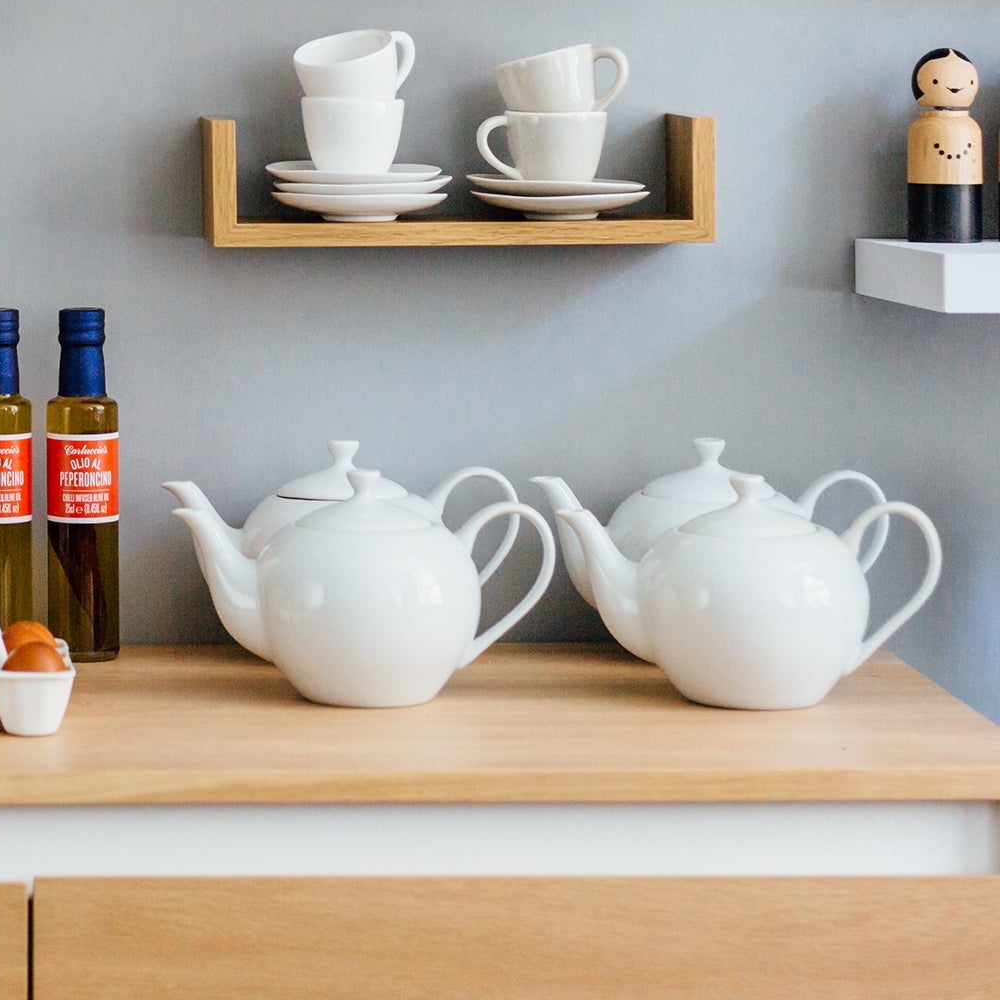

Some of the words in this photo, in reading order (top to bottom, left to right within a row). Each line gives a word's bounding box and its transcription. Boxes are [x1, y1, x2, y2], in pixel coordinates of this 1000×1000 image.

[64, 445, 108, 456] Carluccio's
[3, 458, 13, 470] AL
[70, 457, 90, 470] OLIO
[92, 458, 101, 470] AL
[60, 470, 112, 487] PEPERONCINO
